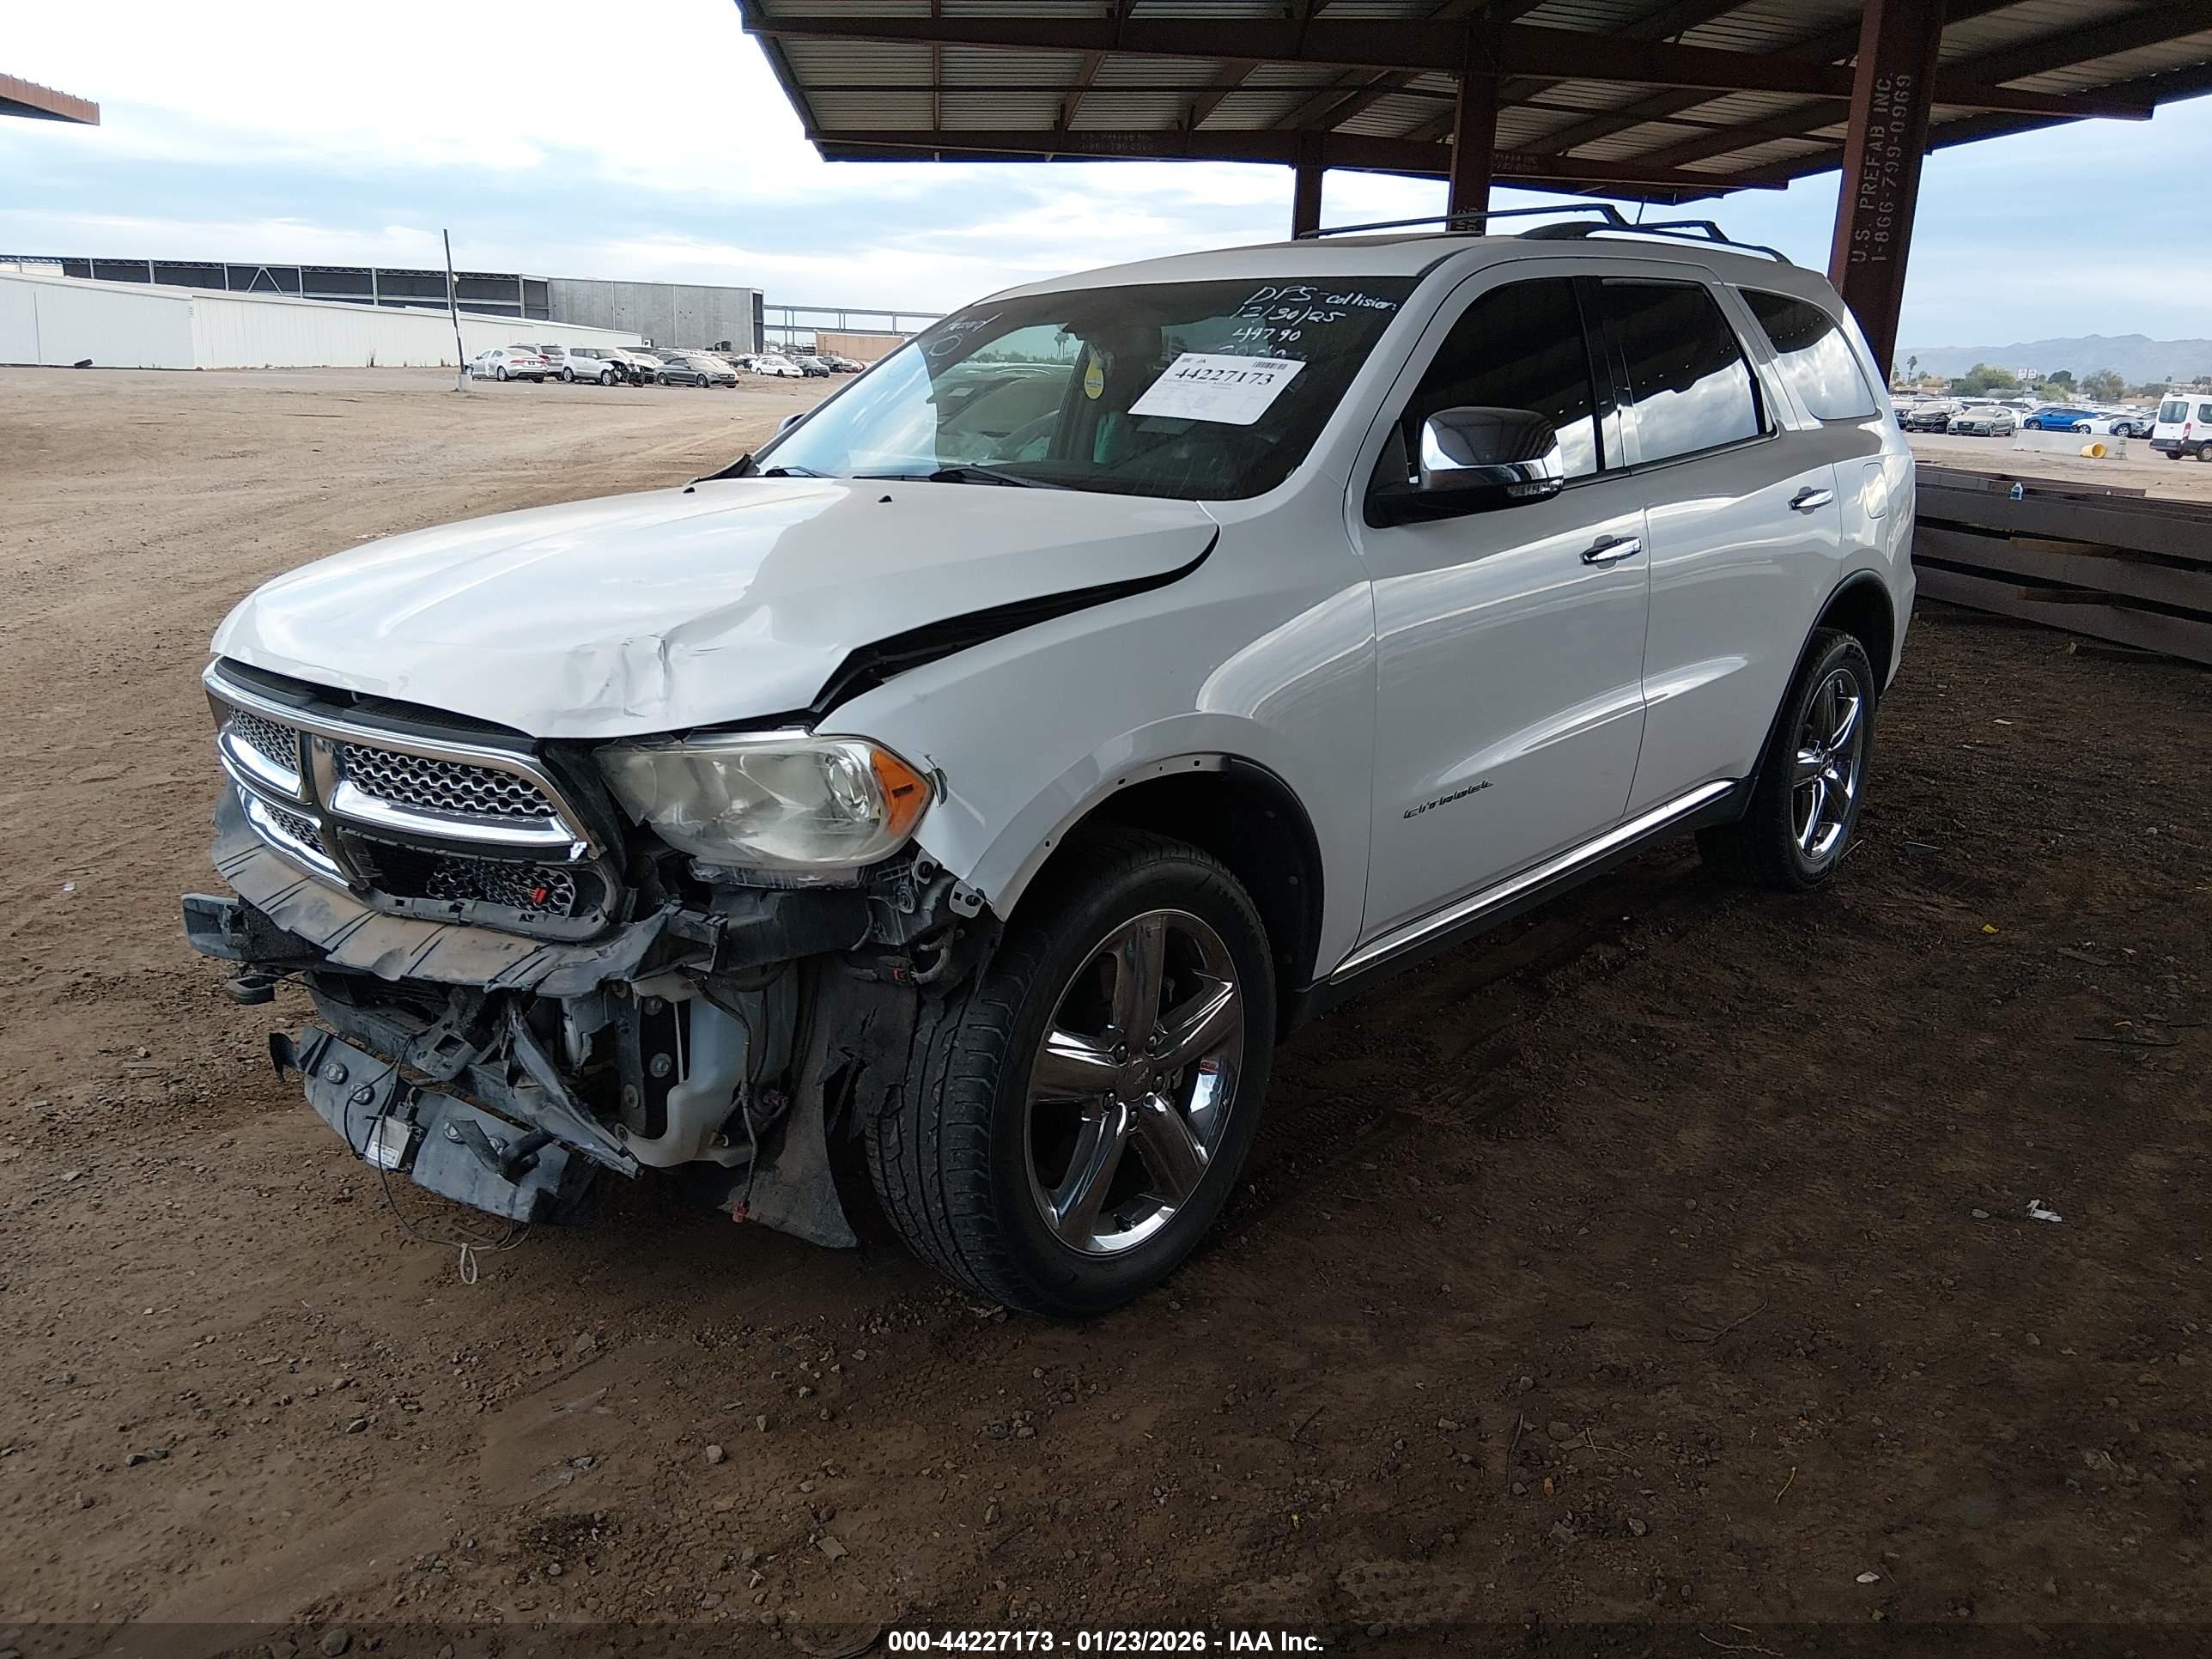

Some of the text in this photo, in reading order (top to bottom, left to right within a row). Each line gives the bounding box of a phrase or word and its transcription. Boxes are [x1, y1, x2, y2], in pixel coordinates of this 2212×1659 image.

[1859, 125, 1886, 210] PREFAB
[1850, 223, 1872, 263] U.S.
[1175, 368, 1275, 386] 44227173
